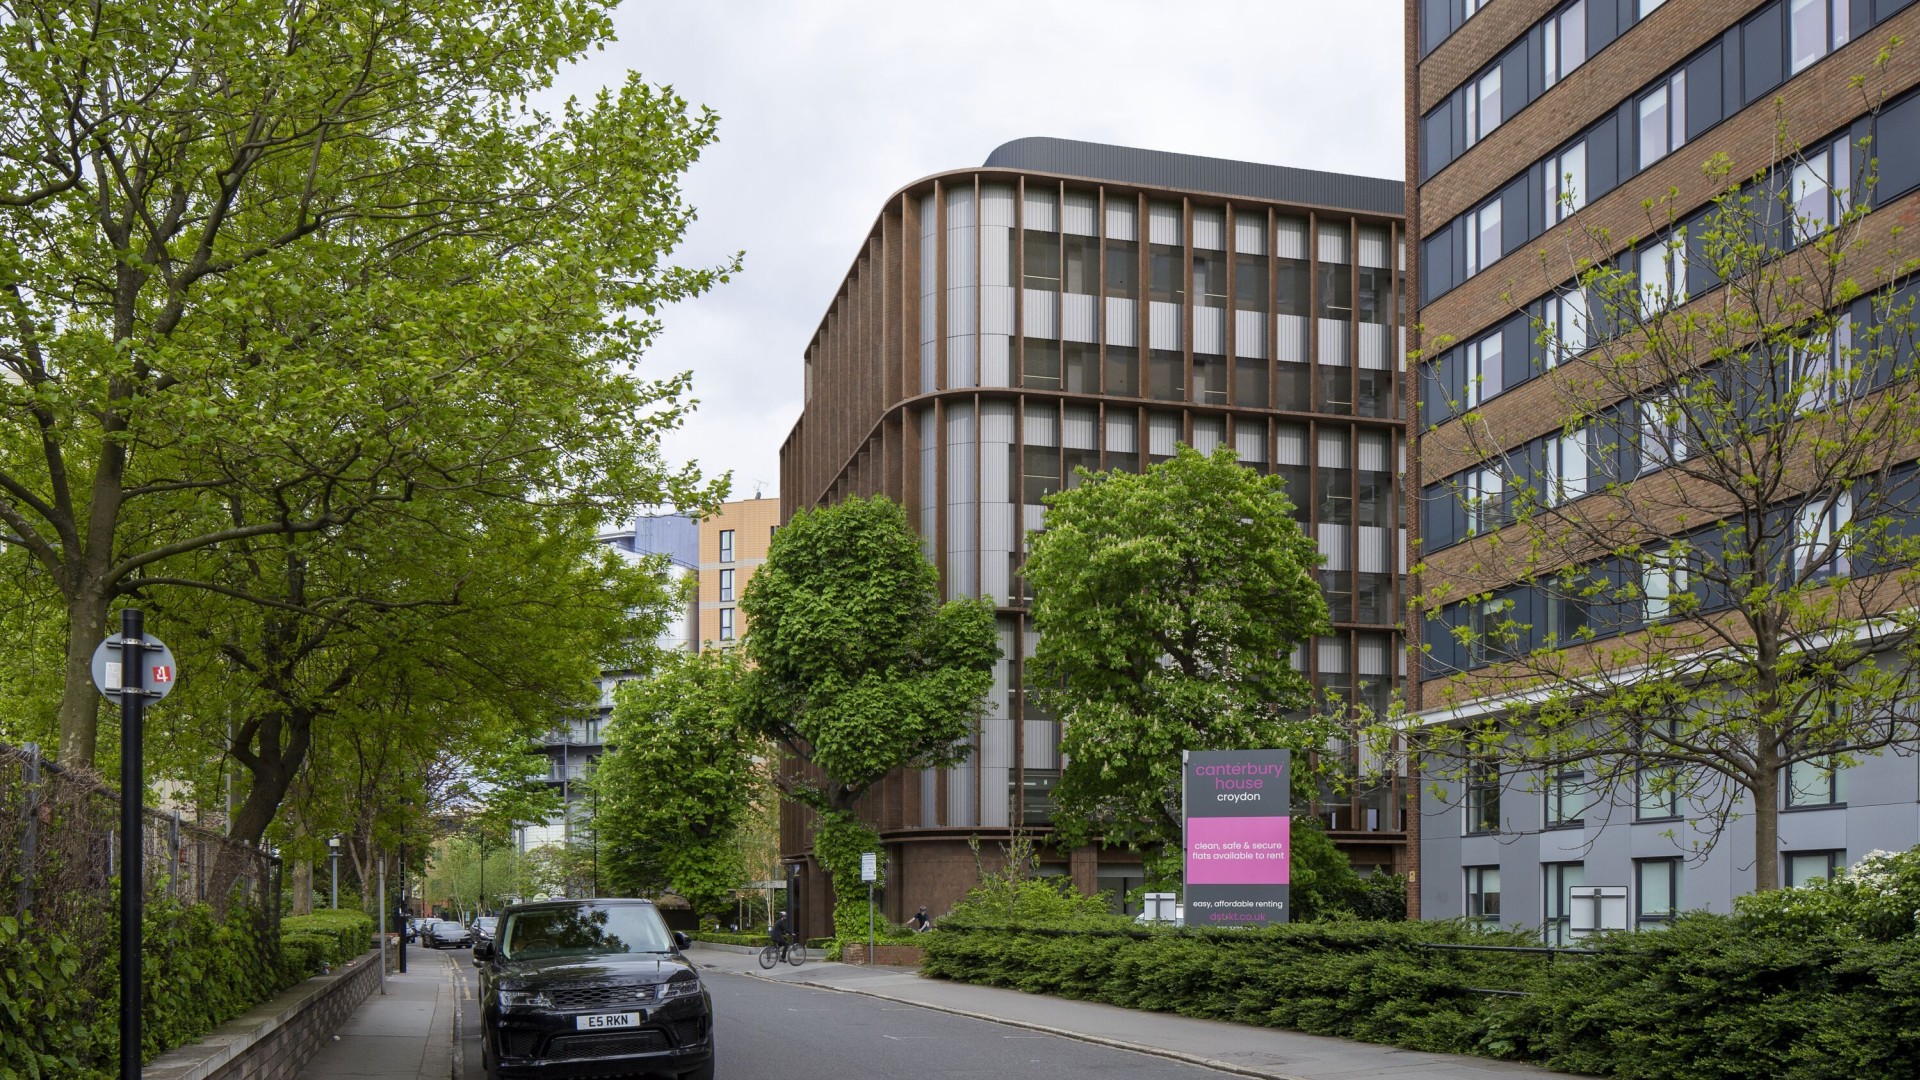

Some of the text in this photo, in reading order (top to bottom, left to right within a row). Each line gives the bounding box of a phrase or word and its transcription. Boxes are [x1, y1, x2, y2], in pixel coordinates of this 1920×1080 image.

[1196, 762, 1283, 778] canterbury
[1216, 778, 1263, 790] house
[1217, 792, 1260, 803] croydon
[1194, 842, 1221, 850] clean,
[1192, 852, 1211, 860] flats
[1213, 852, 1253, 860] available
[1255, 901, 1283, 909] renting
[589, 1015, 628, 1027] E5 RKN
